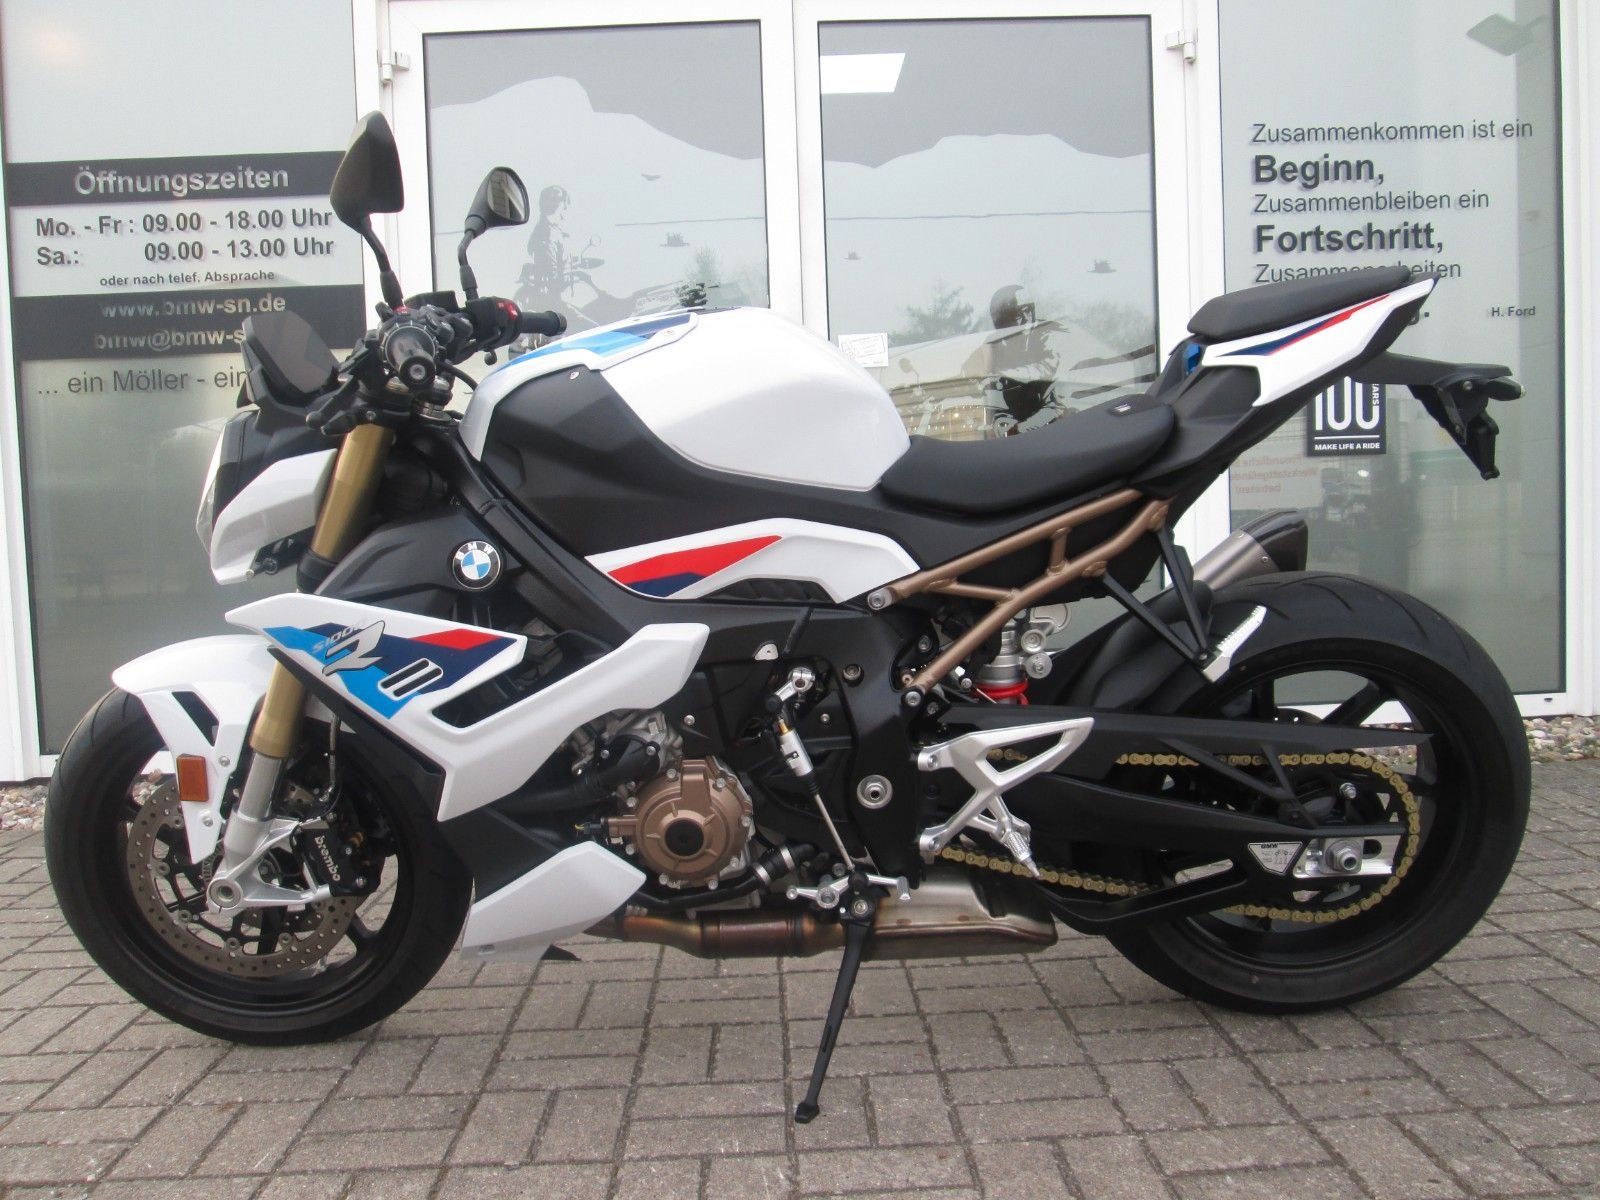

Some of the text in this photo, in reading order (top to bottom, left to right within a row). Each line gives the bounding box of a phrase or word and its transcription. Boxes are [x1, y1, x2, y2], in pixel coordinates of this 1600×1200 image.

[1253, 119, 1533, 143] Zusammenkommen ist ein
[75, 165, 289, 197] Öffnungszeiten
[1254, 153, 1385, 189] Beginn,
[1254, 190, 1489, 213] Zusammenbleiben ein
[37, 217, 76, 237] Mo.
[143, 211, 202, 234] 09.00
[225, 209, 284, 231] 18.00
[292, 207, 333, 228] Uhr
[1256, 220, 1443, 253] Fortschritt,
[145, 241, 204, 263] 09.00
[227, 237, 286, 259] 13.00
[294, 236, 335, 257] Uhr
[100, 269, 275, 287] oder nach telef. Absprache
[1255, 260, 1462, 283] Zusammeiten
[1491, 305, 1537, 318] H. Ford
[68, 370, 103, 394] ein
[113, 367, 190, 393] Möller
[1315, 442, 1380, 451] MAKE LIFE A RIDE
[455, 541, 495, 561] BMW
[315, 835, 341, 882] brembo
